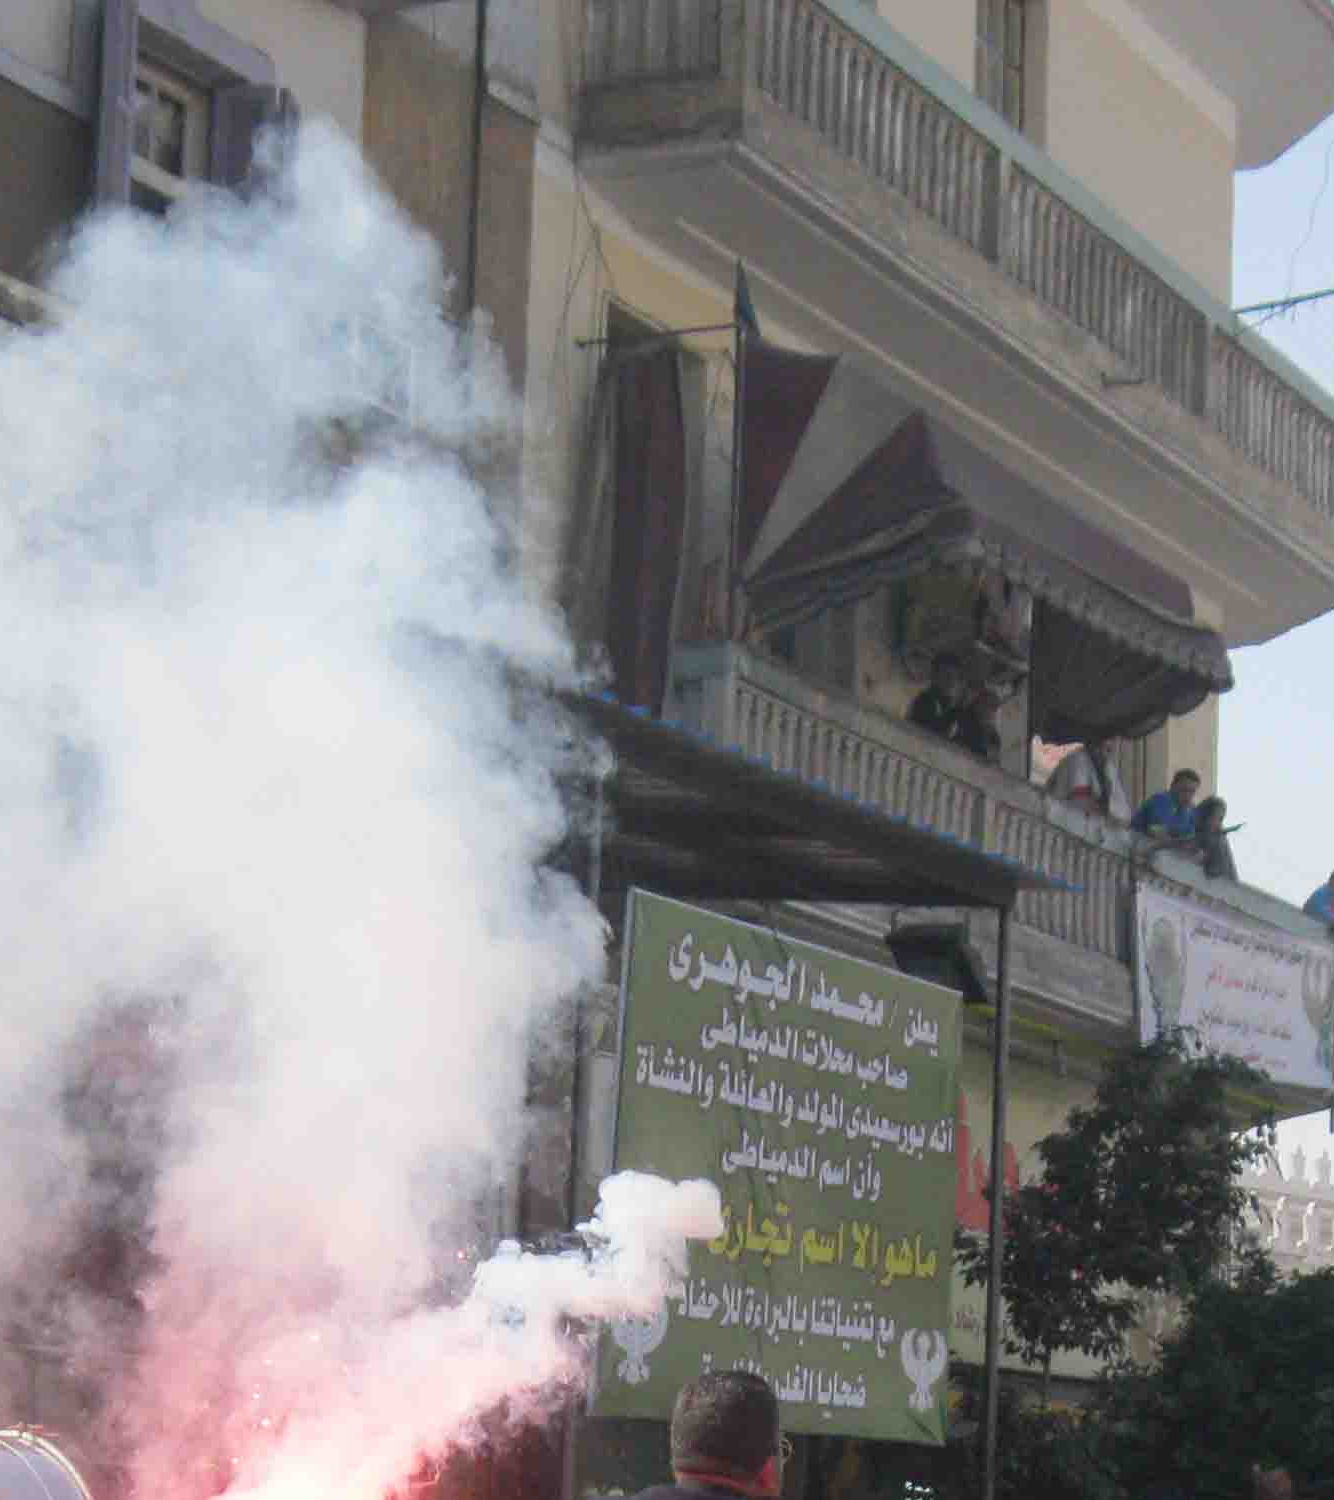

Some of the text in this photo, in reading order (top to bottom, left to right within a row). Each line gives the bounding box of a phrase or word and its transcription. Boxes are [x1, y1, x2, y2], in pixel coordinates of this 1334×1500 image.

[810, 970, 884, 1025] محمد
[802, 1028, 855, 1076] محلات
[856, 1055, 908, 1091] صاحب
[797, 1086, 845, 1135] المولد
[818, 1156, 851, 1193] اسم
[799, 1222, 844, 1273] اسم
[876, 1314, 896, 1360] مع
